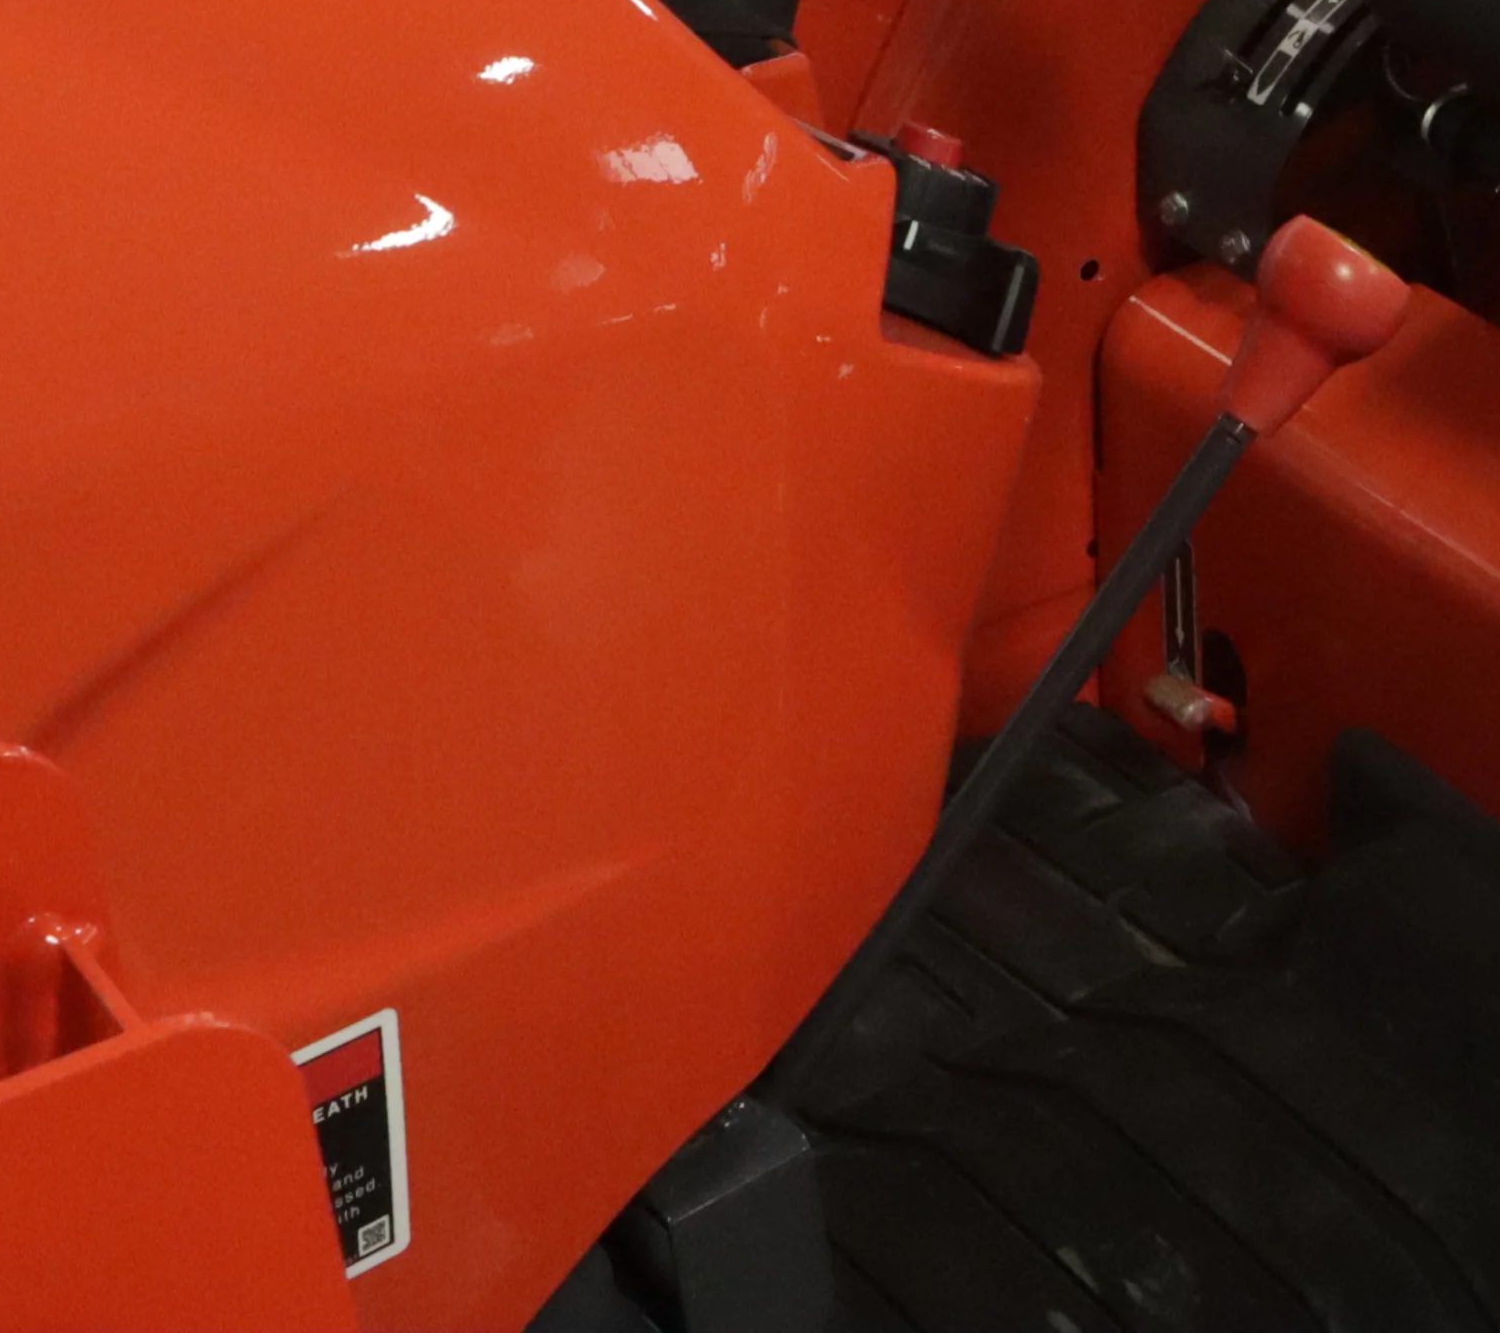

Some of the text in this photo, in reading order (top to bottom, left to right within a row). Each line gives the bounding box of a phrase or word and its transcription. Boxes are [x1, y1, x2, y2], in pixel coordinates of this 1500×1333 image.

[311, 1085, 369, 1124] EATH
[332, 1165, 364, 1191] and
[334, 1177, 381, 1209] ssed.
[337, 1206, 360, 1225] ith
